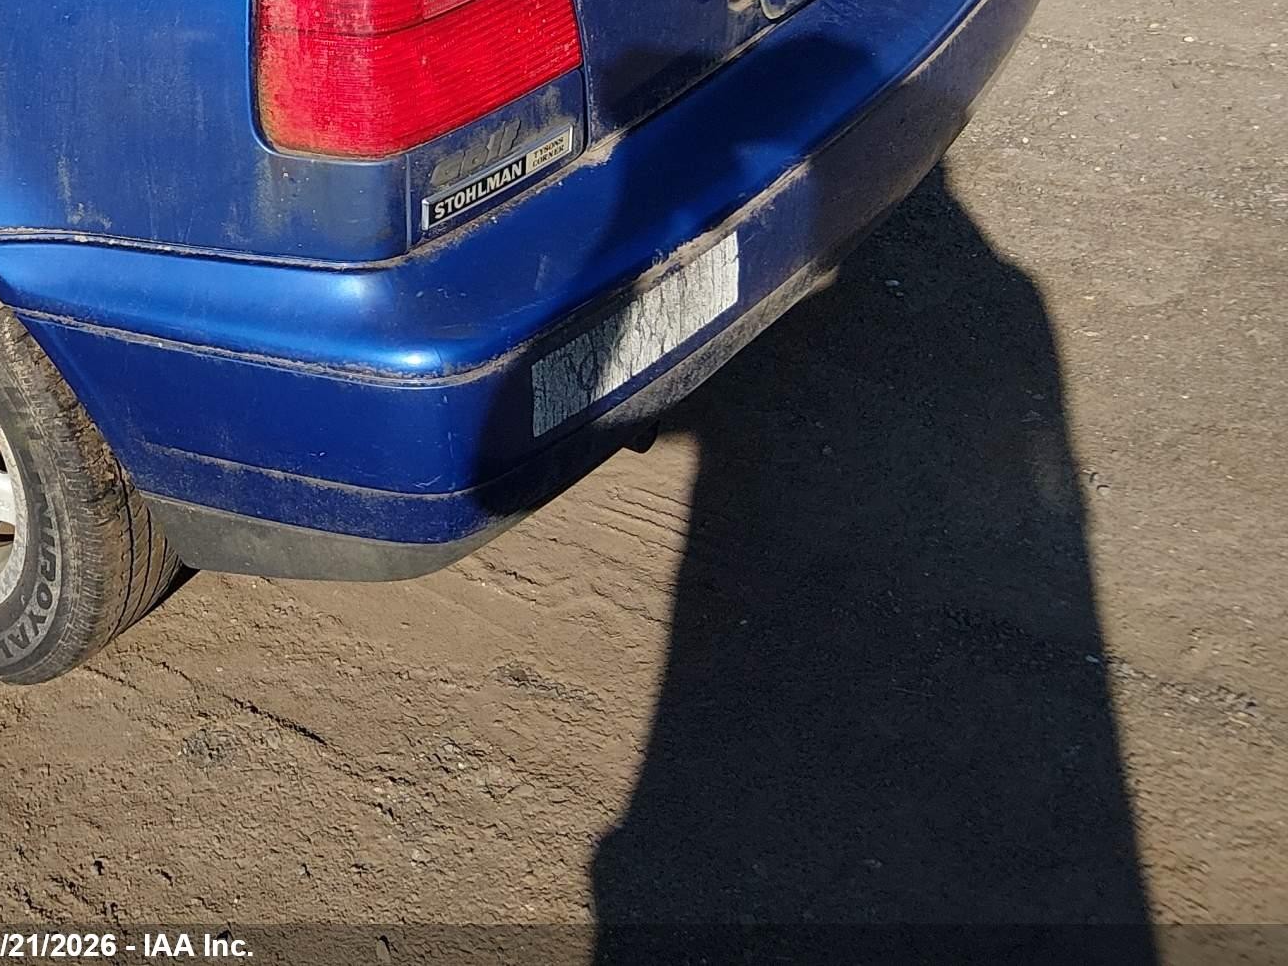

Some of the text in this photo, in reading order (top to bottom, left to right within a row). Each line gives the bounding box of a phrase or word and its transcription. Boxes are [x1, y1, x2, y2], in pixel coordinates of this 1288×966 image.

[532, 137, 564, 159] TYSONS
[532, 144, 566, 168] CORNER
[434, 161, 523, 219] STOHLMAN
